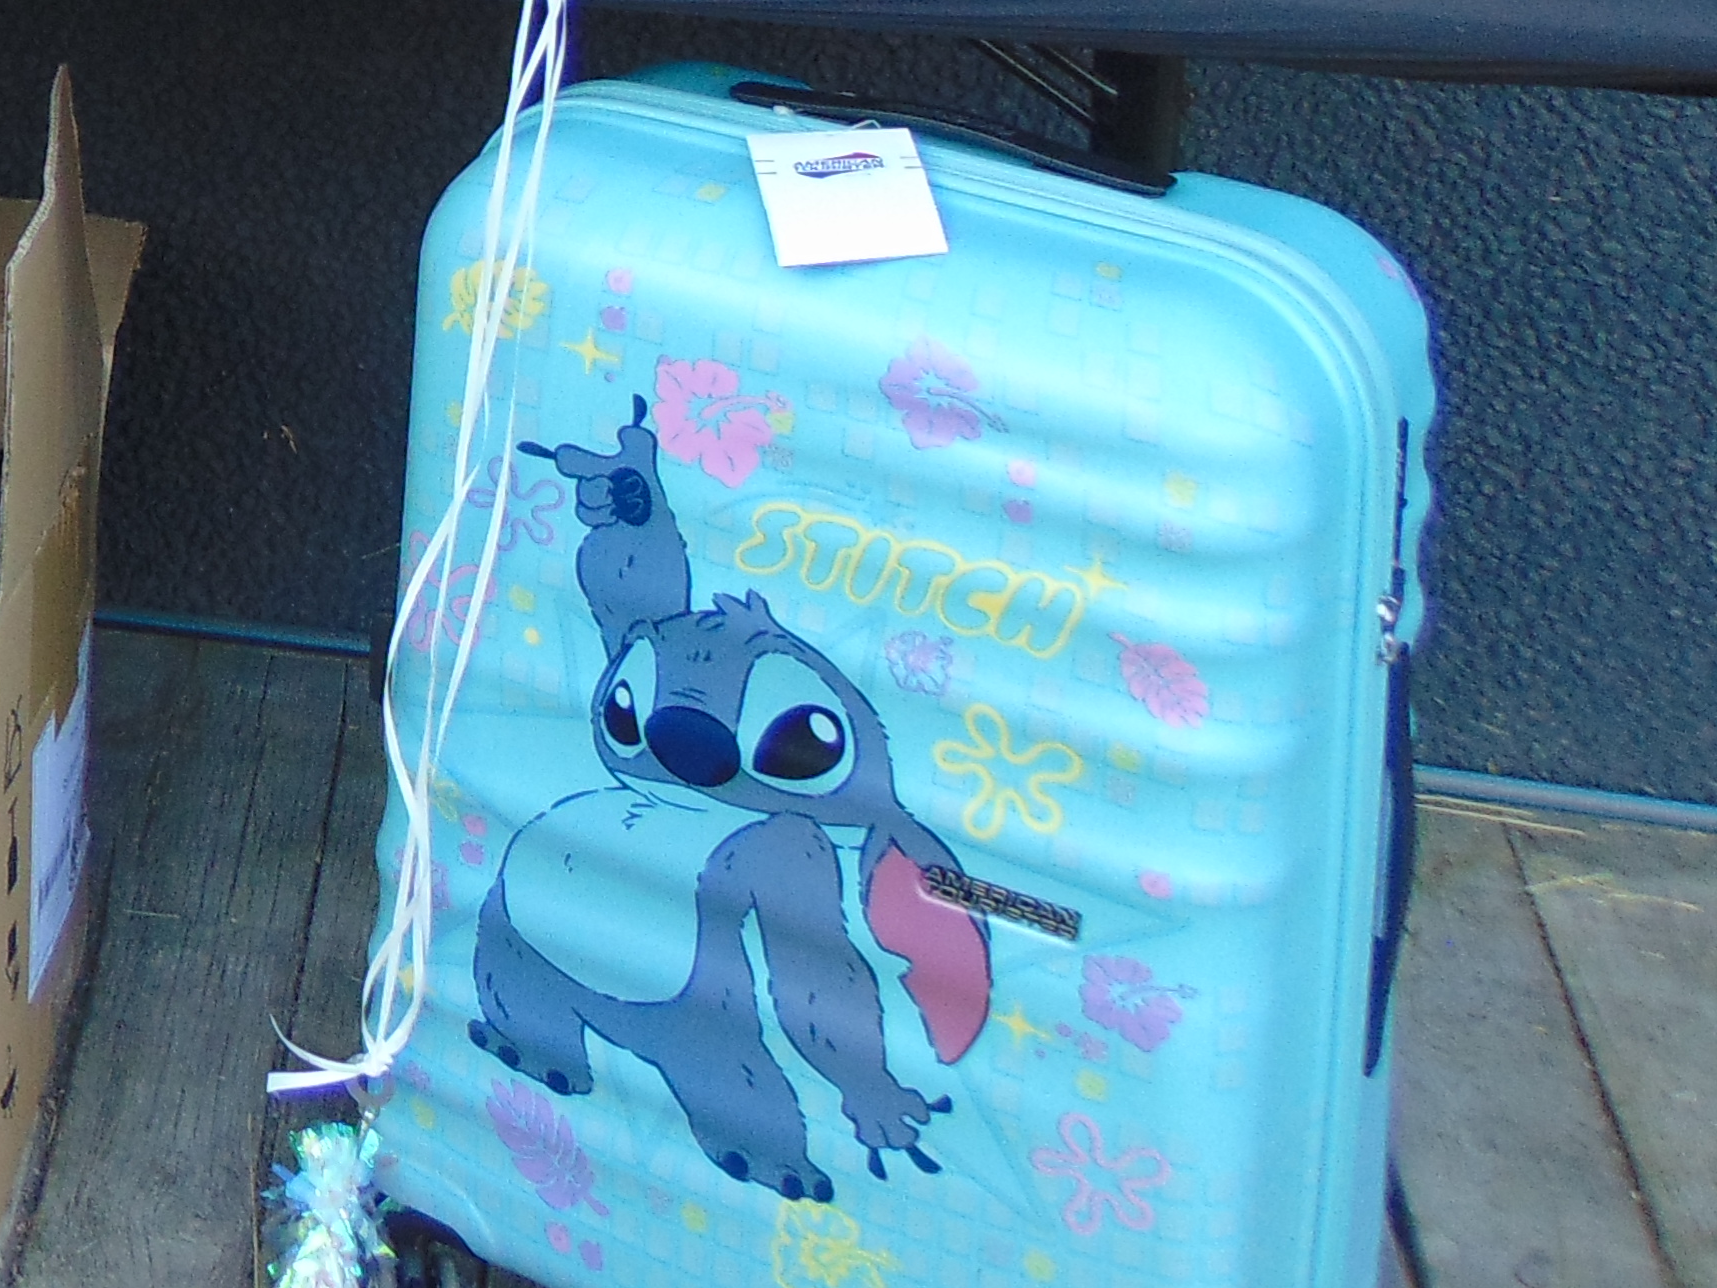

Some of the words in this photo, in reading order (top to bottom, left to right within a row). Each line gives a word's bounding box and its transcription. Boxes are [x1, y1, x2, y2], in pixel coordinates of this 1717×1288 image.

[734, 501, 1086, 661] STITCH
[926, 866, 1081, 923] AMERICAN
[927, 880, 1078, 940] TOURISTER
